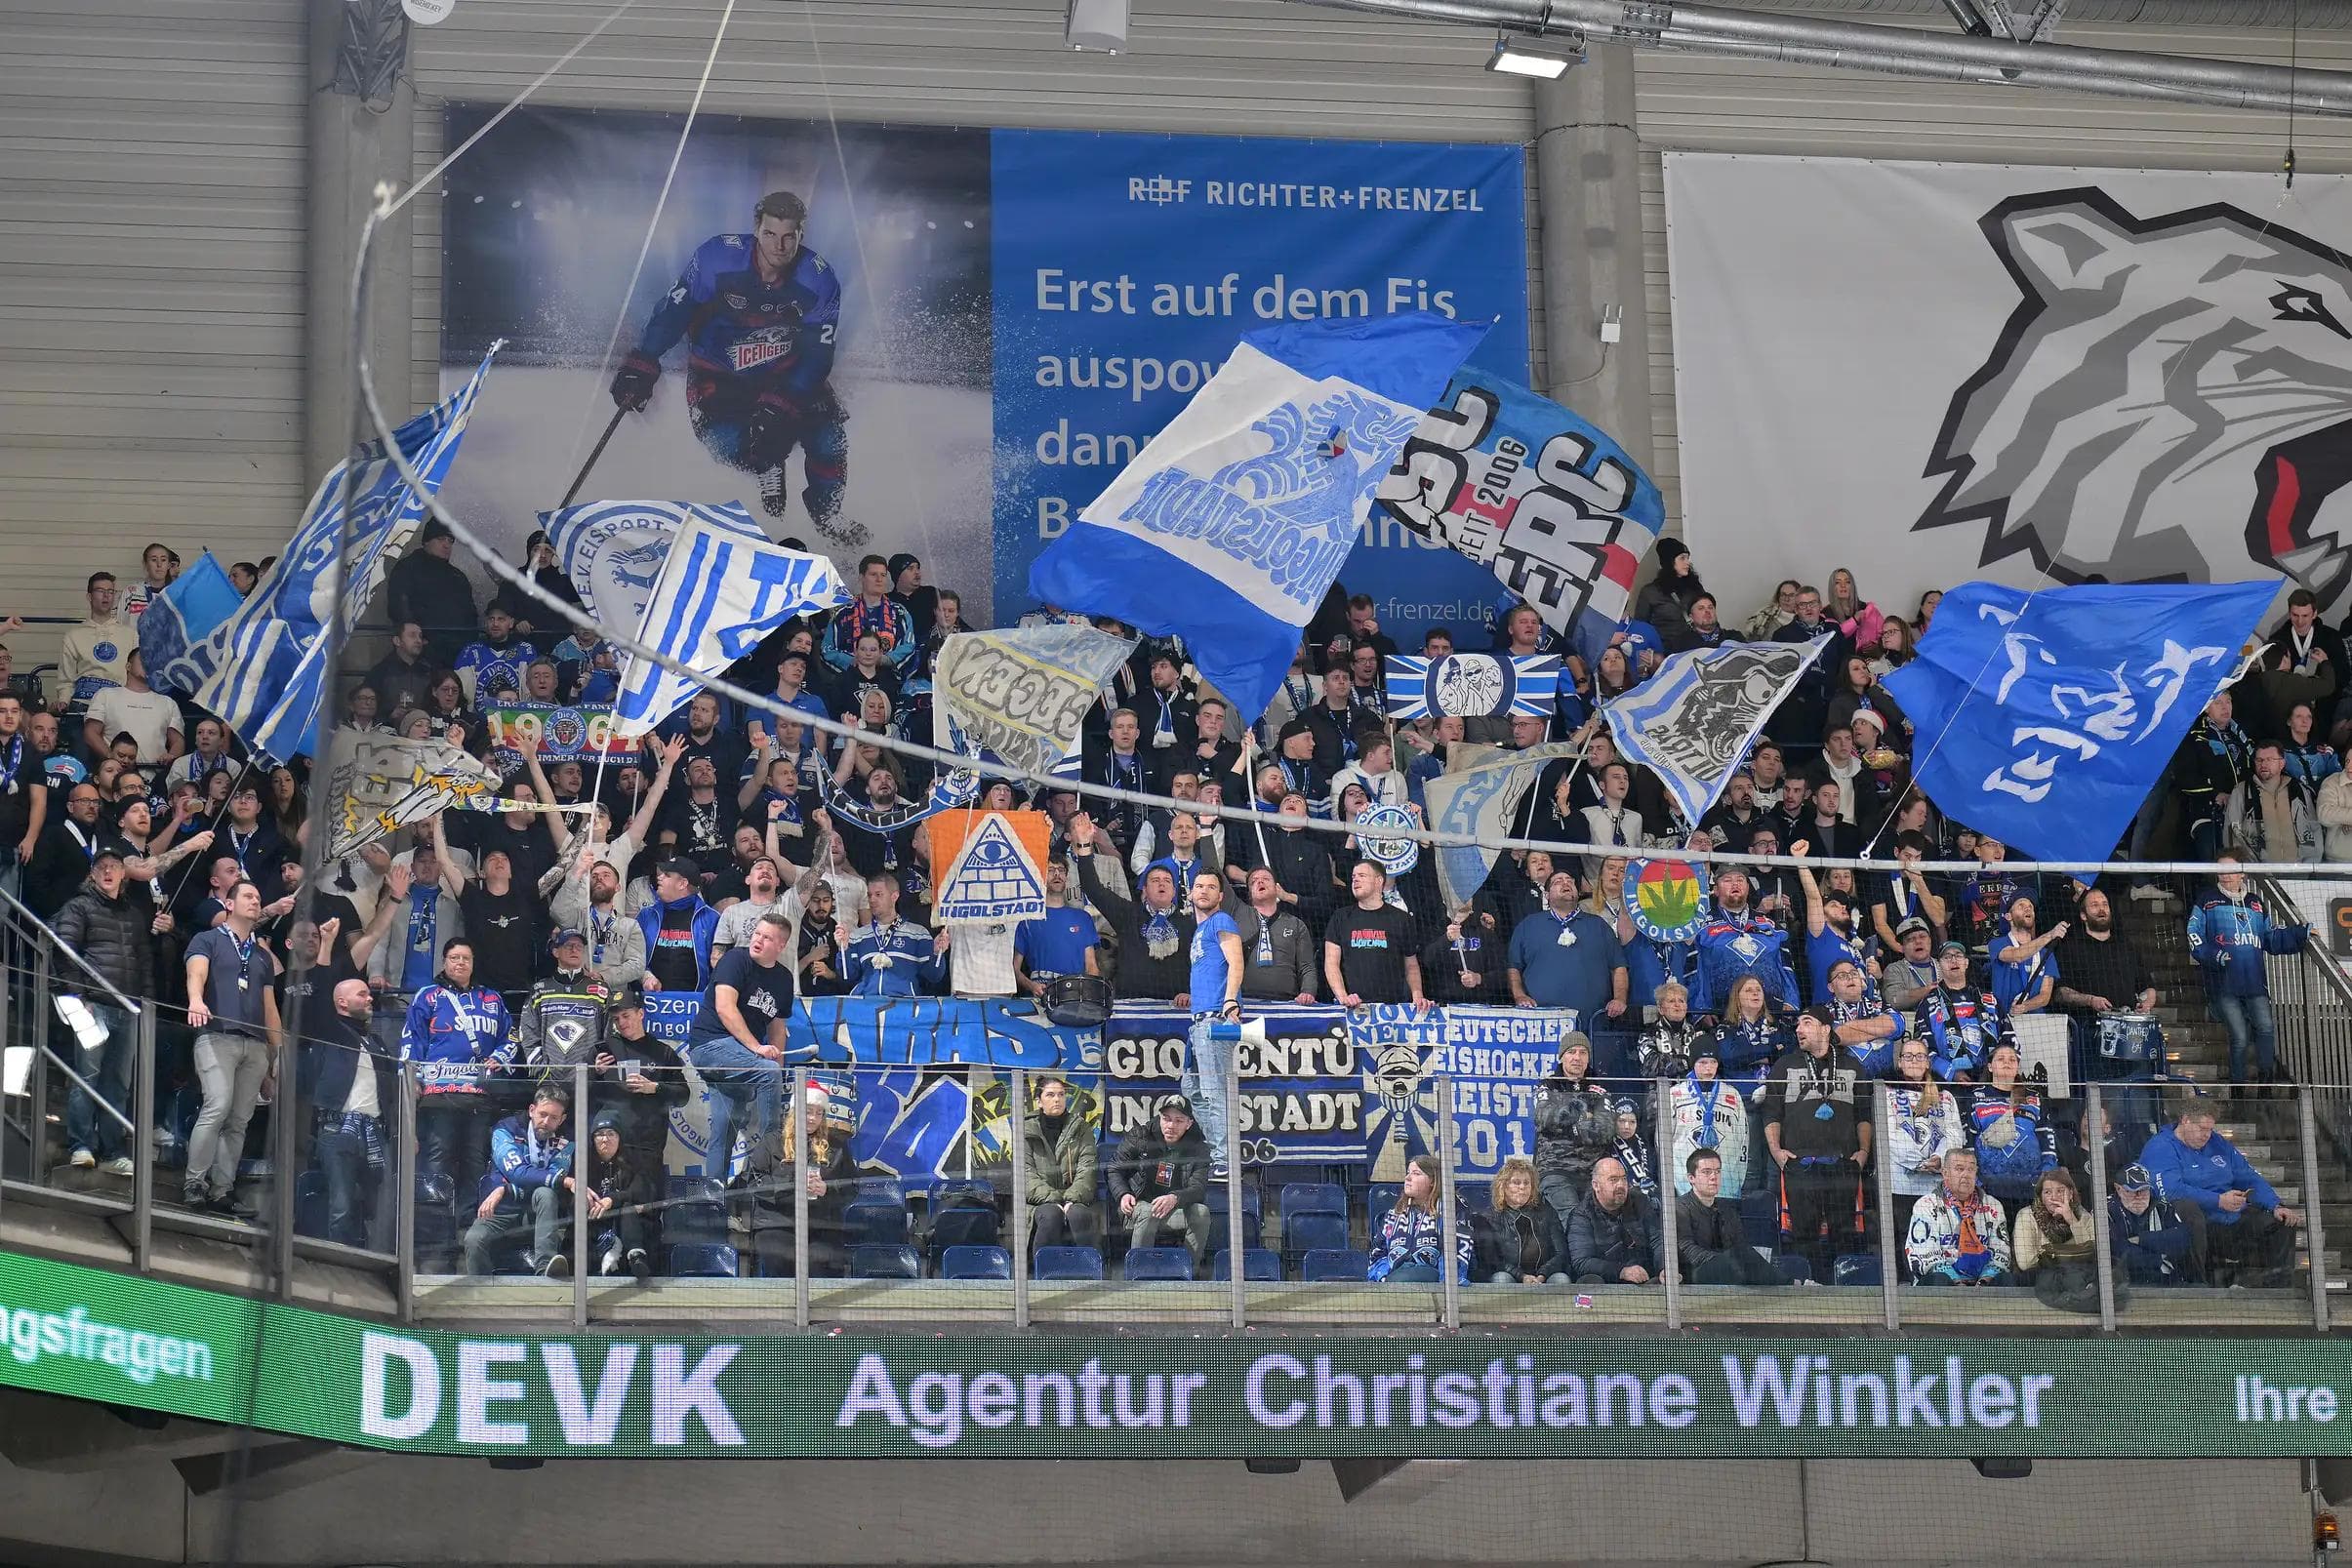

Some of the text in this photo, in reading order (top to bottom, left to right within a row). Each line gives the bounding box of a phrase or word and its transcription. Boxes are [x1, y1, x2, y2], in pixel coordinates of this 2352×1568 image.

[1206, 180, 1484, 213] RICHTER+FRENZEL
[1035, 268, 1136, 315] Erst
[1151, 273, 1240, 317] auf
[1252, 273, 1367, 321] dem
[1474, 436, 1527, 508] 2006
[1492, 430, 1638, 637] ERC
[643, 995, 700, 1016] Szen
[1346, 1003, 1446, 1025] GIOVA
[645, 1019, 691, 1037] Ingol
[1349, 1022, 1449, 1047] NETTI
[1451, 1018, 1575, 1043] EUTSCHER
[1107, 1026, 1355, 1079] GIOENTÙ
[1109, 1092, 1361, 1133] INSTADT
[1434, 1118, 1536, 1169] 201
[360, 1329, 748, 1448] DEVK
[834, 1351, 1206, 1448] Agentur
[1243, 1351, 1698, 1429] Christiane
[1721, 1353, 2055, 1428] Winkler
[2234, 1373, 2339, 1424] Ihre
